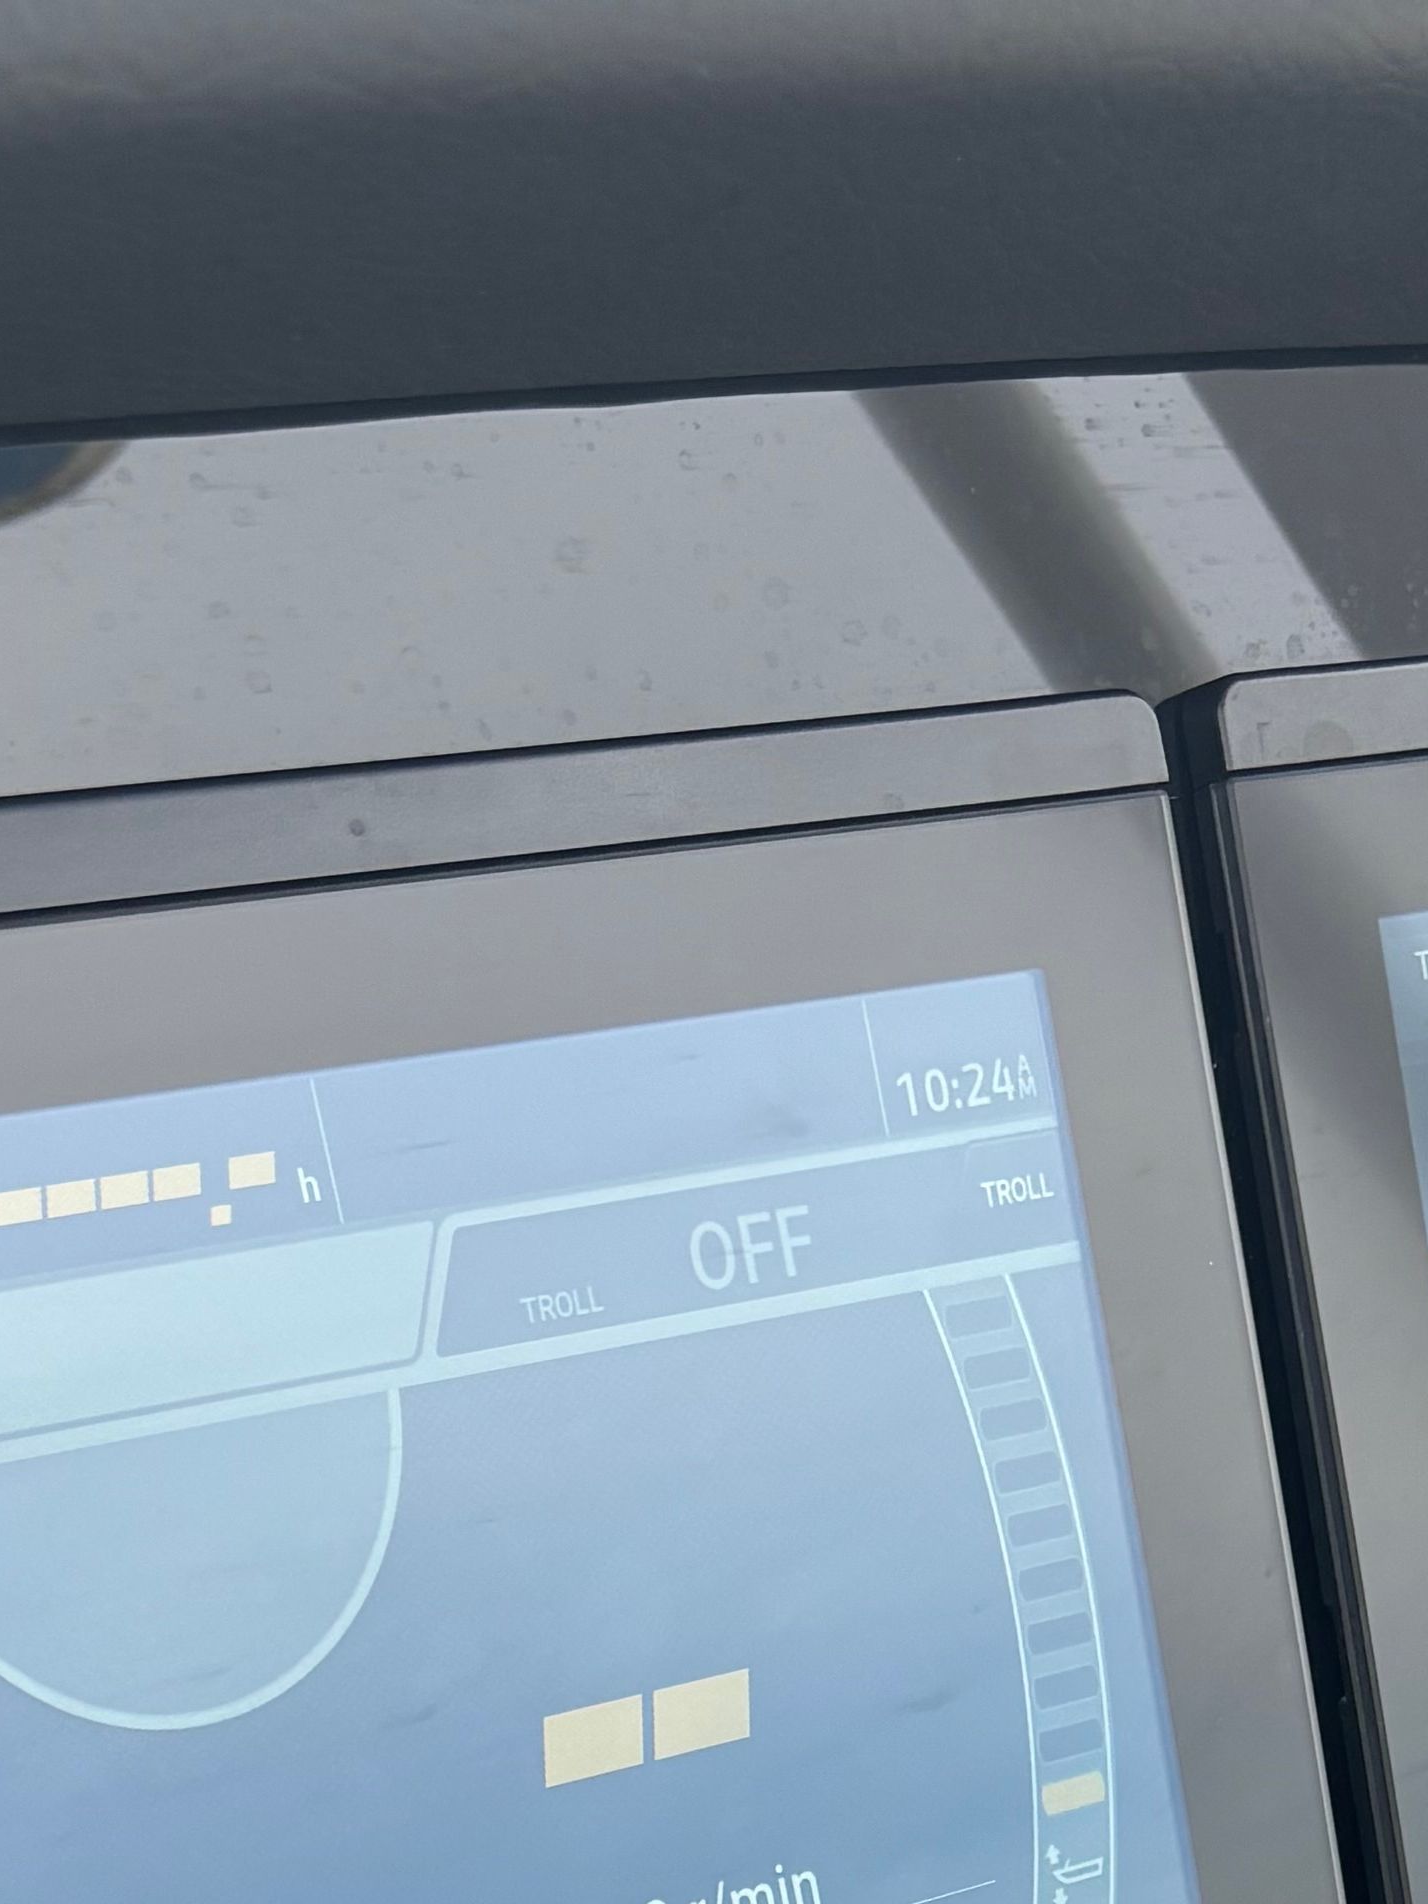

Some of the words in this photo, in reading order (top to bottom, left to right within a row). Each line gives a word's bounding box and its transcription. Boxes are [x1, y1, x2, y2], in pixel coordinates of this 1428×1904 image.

[896, 1057, 1015, 1117] 10:24
[297, 1166, 322, 1205] h
[980, 1172, 1054, 1208] TROLL
[689, 1205, 814, 1294] OFF
[520, 1287, 605, 1326] TROLL
